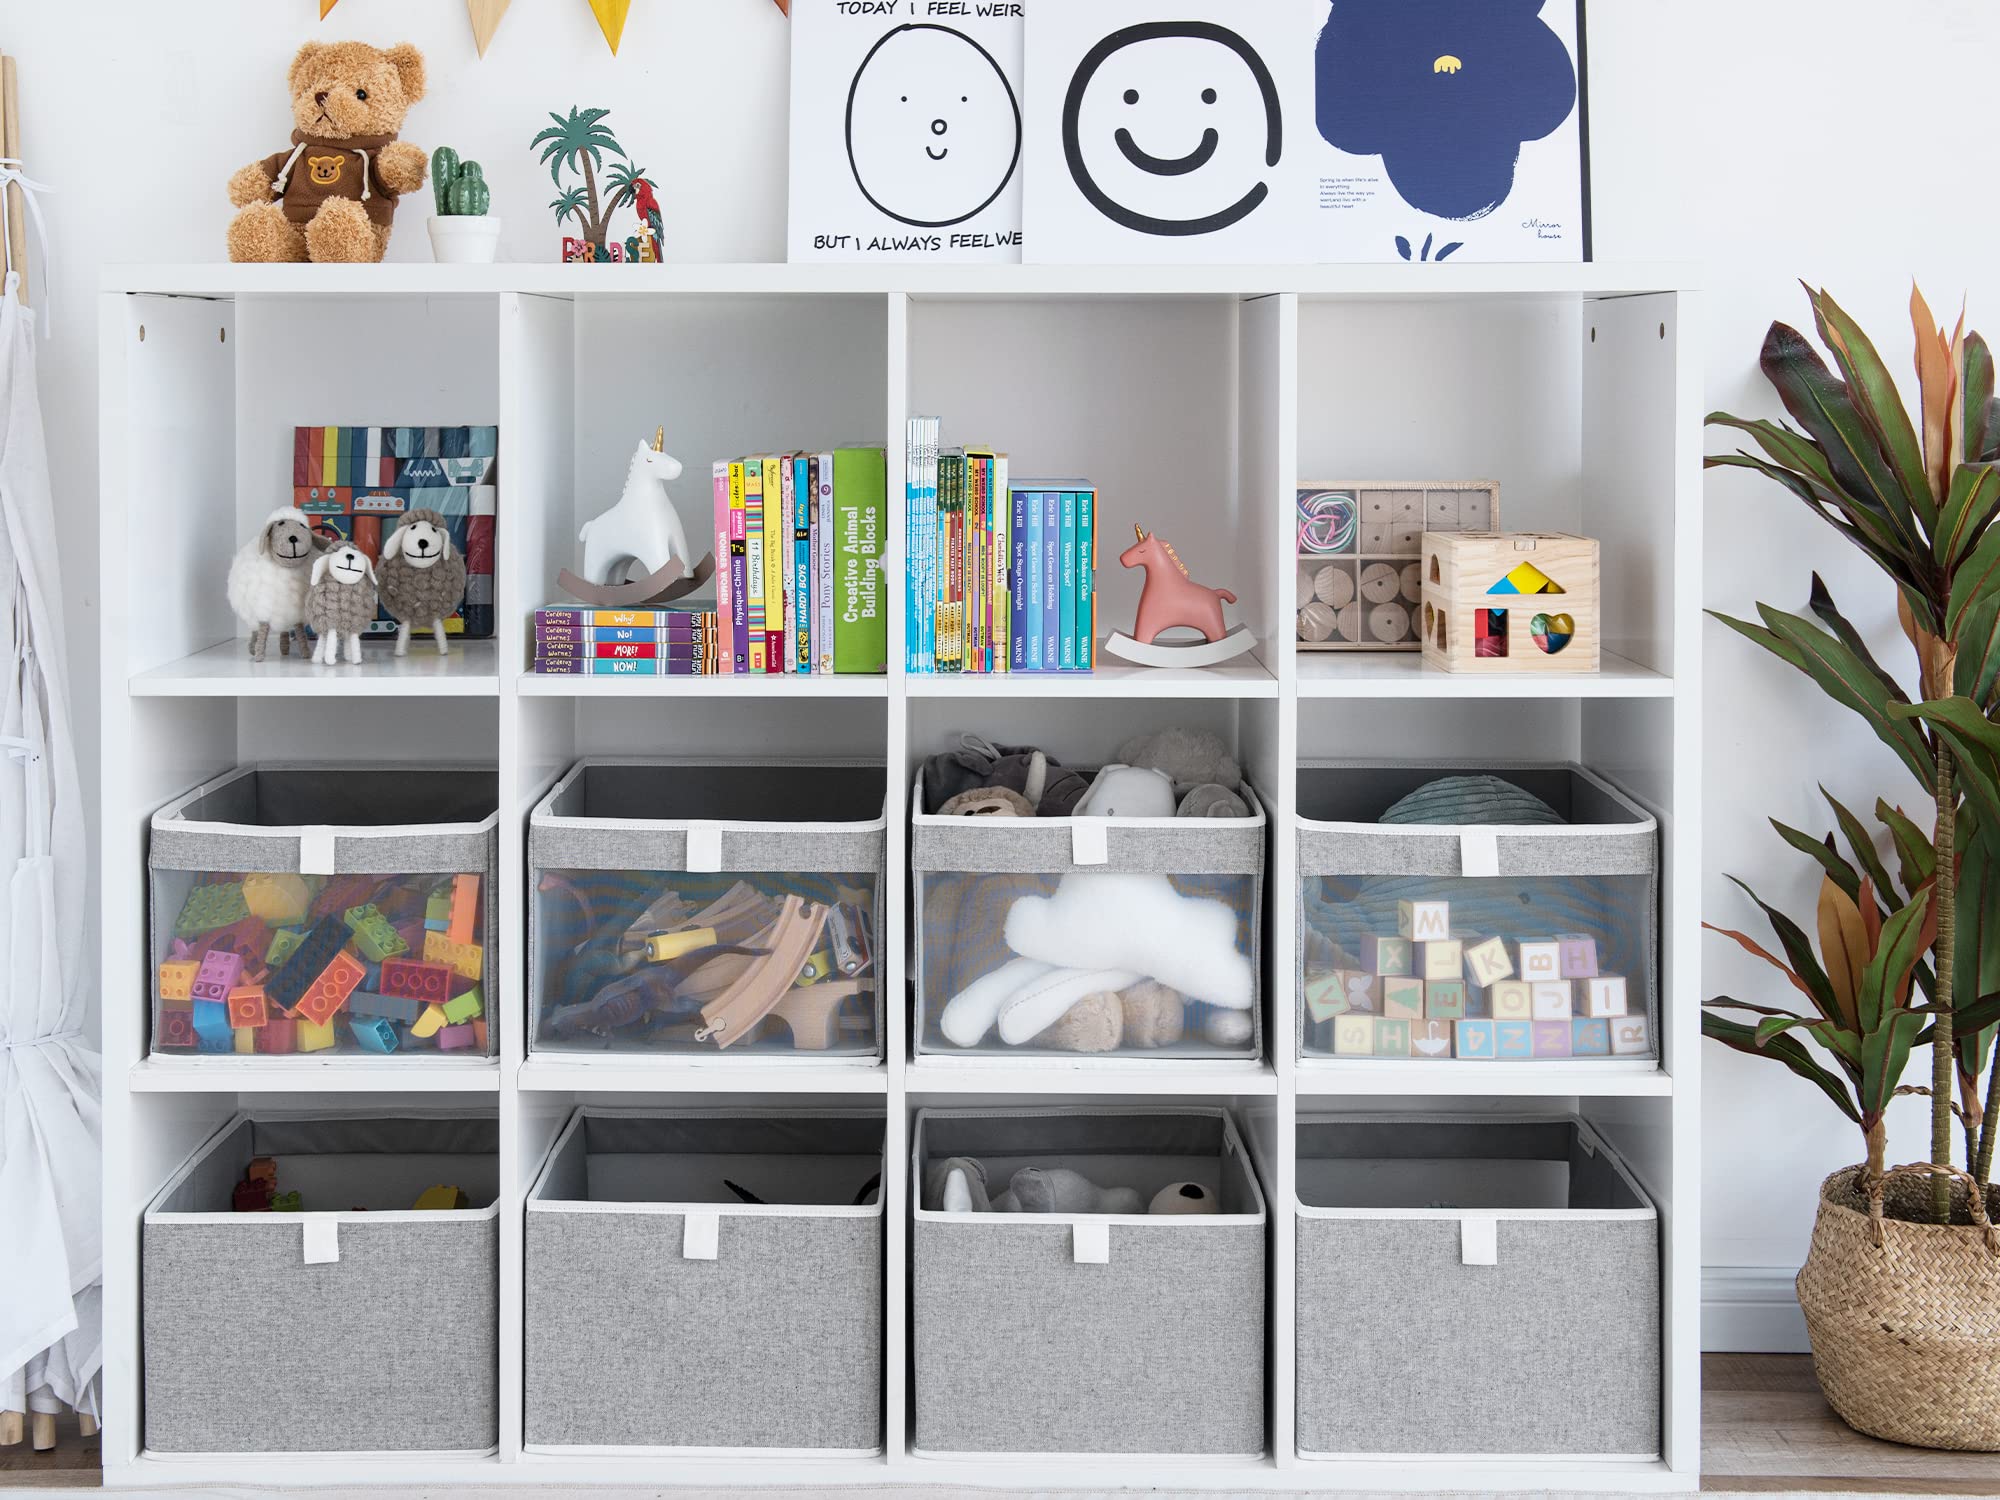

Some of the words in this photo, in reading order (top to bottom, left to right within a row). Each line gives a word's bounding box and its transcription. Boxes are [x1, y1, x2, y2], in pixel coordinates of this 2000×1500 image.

[837, 0, 898, 15] TODAY
[910, 2, 915, 15] I
[928, 2, 971, 16] FEEL
[1522, 218, 1562, 229] Mirror
[1538, 229, 1562, 239] house
[813, 235, 851, 250] BUT
[855, 237, 861, 251] I
[867, 235, 942, 251] ALWAYS
[950, 233, 995, 248] FEEL
[1064, 499, 1072, 514] Eric
[840, 506, 858, 554] Animal
[859, 506, 876, 554] Blocks
[1064, 515, 1072, 528] Hill
[719, 531, 728, 568] WONDER
[820, 542, 831, 579] Stories
[1015, 542, 1023, 557] Spot
[1047, 541, 1055, 556] Spot
[1064, 542, 1072, 568] Where's
[1080, 541, 1088, 556] Spot
[751, 555, 761, 595] Birthdays
[798, 564, 807, 589] BOYS
[1015, 558, 1023, 577] Stays
[1063, 569, 1072, 587] Spot?
[719, 571, 728, 605] WOMEN
[733, 560, 744, 626] Physique-Chimie
[820, 583, 832, 609] Pony
[842, 559, 858, 623] Creative
[859, 558, 880, 618] Building
[1015, 578, 1024, 611] Overnight
[1046, 584, 1055, 610] Holiday
[614, 614, 635, 624] Why?
[798, 590, 807, 624] HARDY
[617, 629, 633, 639] No!
[614, 645, 638, 657] MORE!
[1015, 636, 1023, 663] WARNE
[1047, 636, 1055, 663] WARNE
[613, 660, 638, 672] NOW!
[1385, 944, 1403, 969] X
[1479, 947, 1505, 975] K
[1529, 953, 1552, 971] B
[1434, 991, 1457, 1008] E
[1382, 1026, 1402, 1049] H
[1619, 1025, 1644, 1044] R
